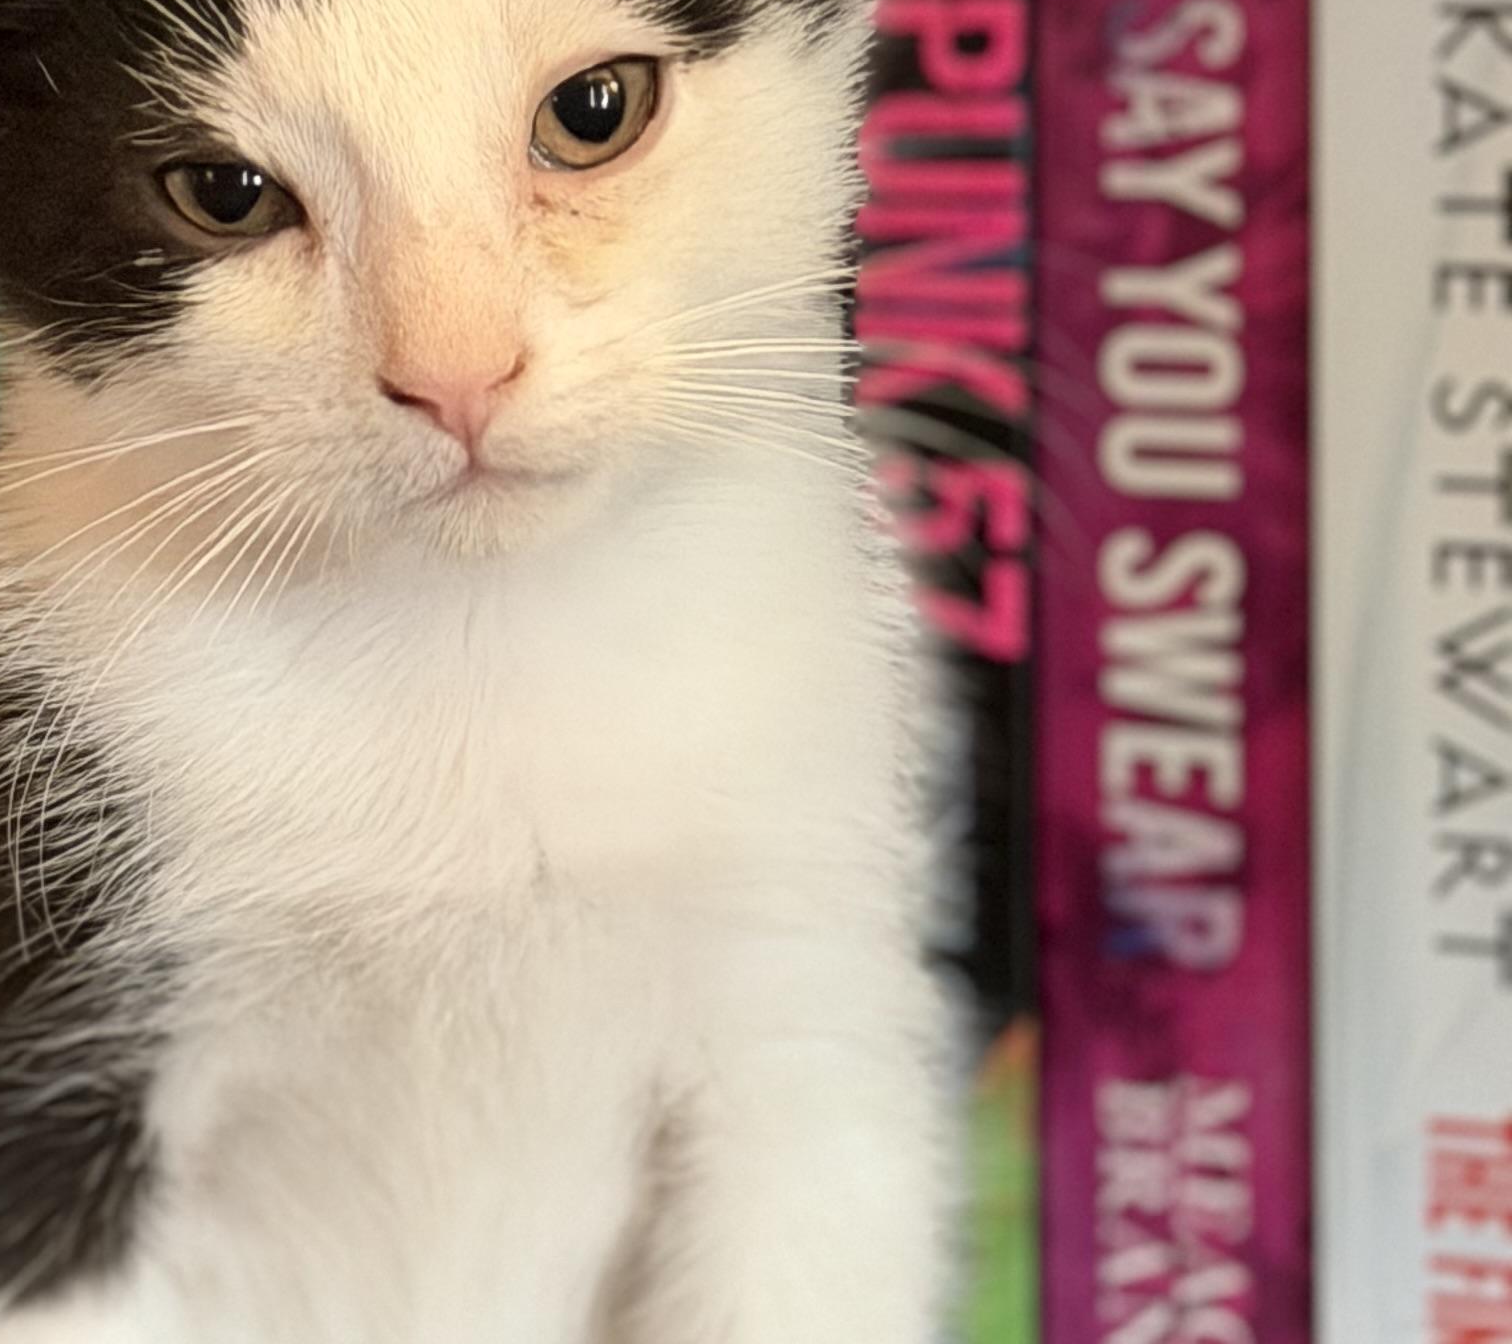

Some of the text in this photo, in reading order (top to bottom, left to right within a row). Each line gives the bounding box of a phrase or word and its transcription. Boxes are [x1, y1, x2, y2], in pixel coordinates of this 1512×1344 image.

[1096, 242, 1246, 499] YOU
[874, 454, 1029, 662] 57
[1428, 0, 1512, 987] KATE STEWART
[1423, 1111, 1512, 1233] THE
